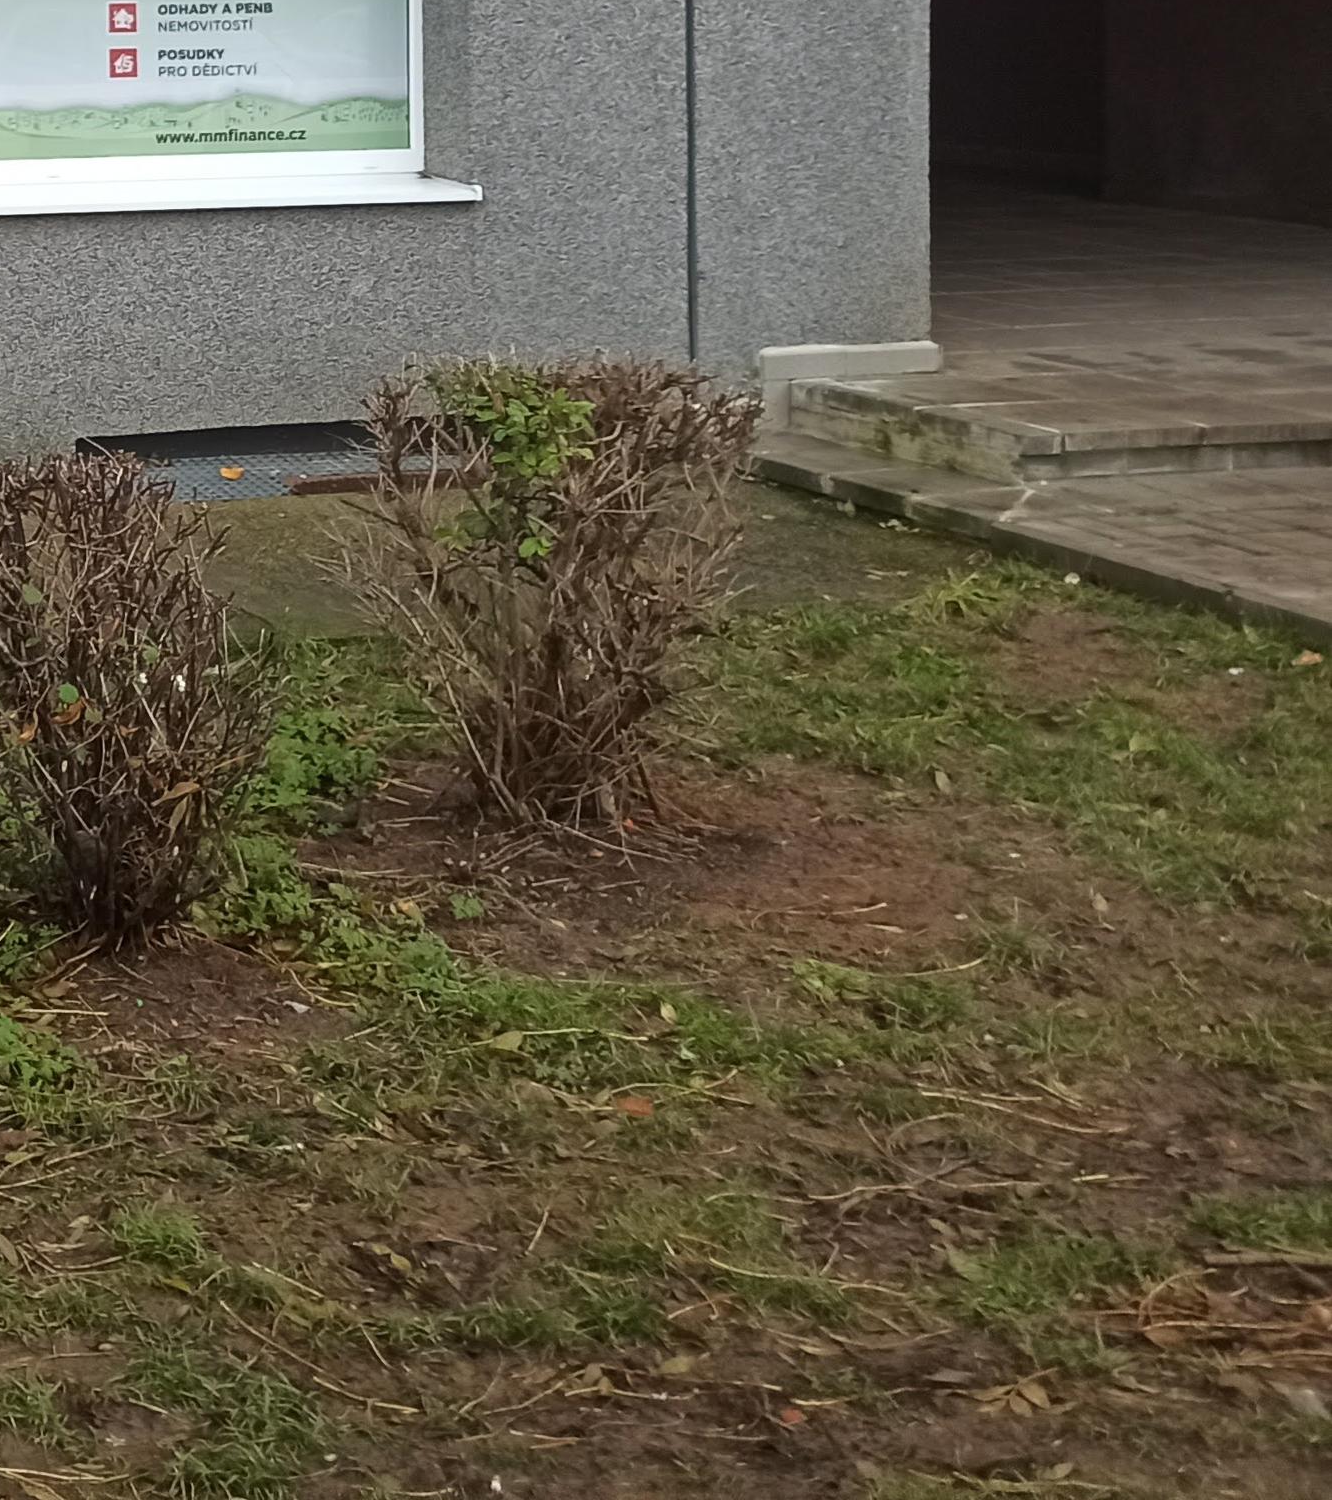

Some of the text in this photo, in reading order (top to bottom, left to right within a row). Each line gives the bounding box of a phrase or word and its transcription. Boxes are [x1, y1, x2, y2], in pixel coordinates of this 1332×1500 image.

[157, 1, 273, 16] ODHADY A PENB
[157, 17, 254, 33] NEMOVITOSTÍ
[157, 48, 225, 61] POSUDKY
[157, 64, 188, 78] PRO
[155, 127, 307, 146] www.mmfinance.cz
